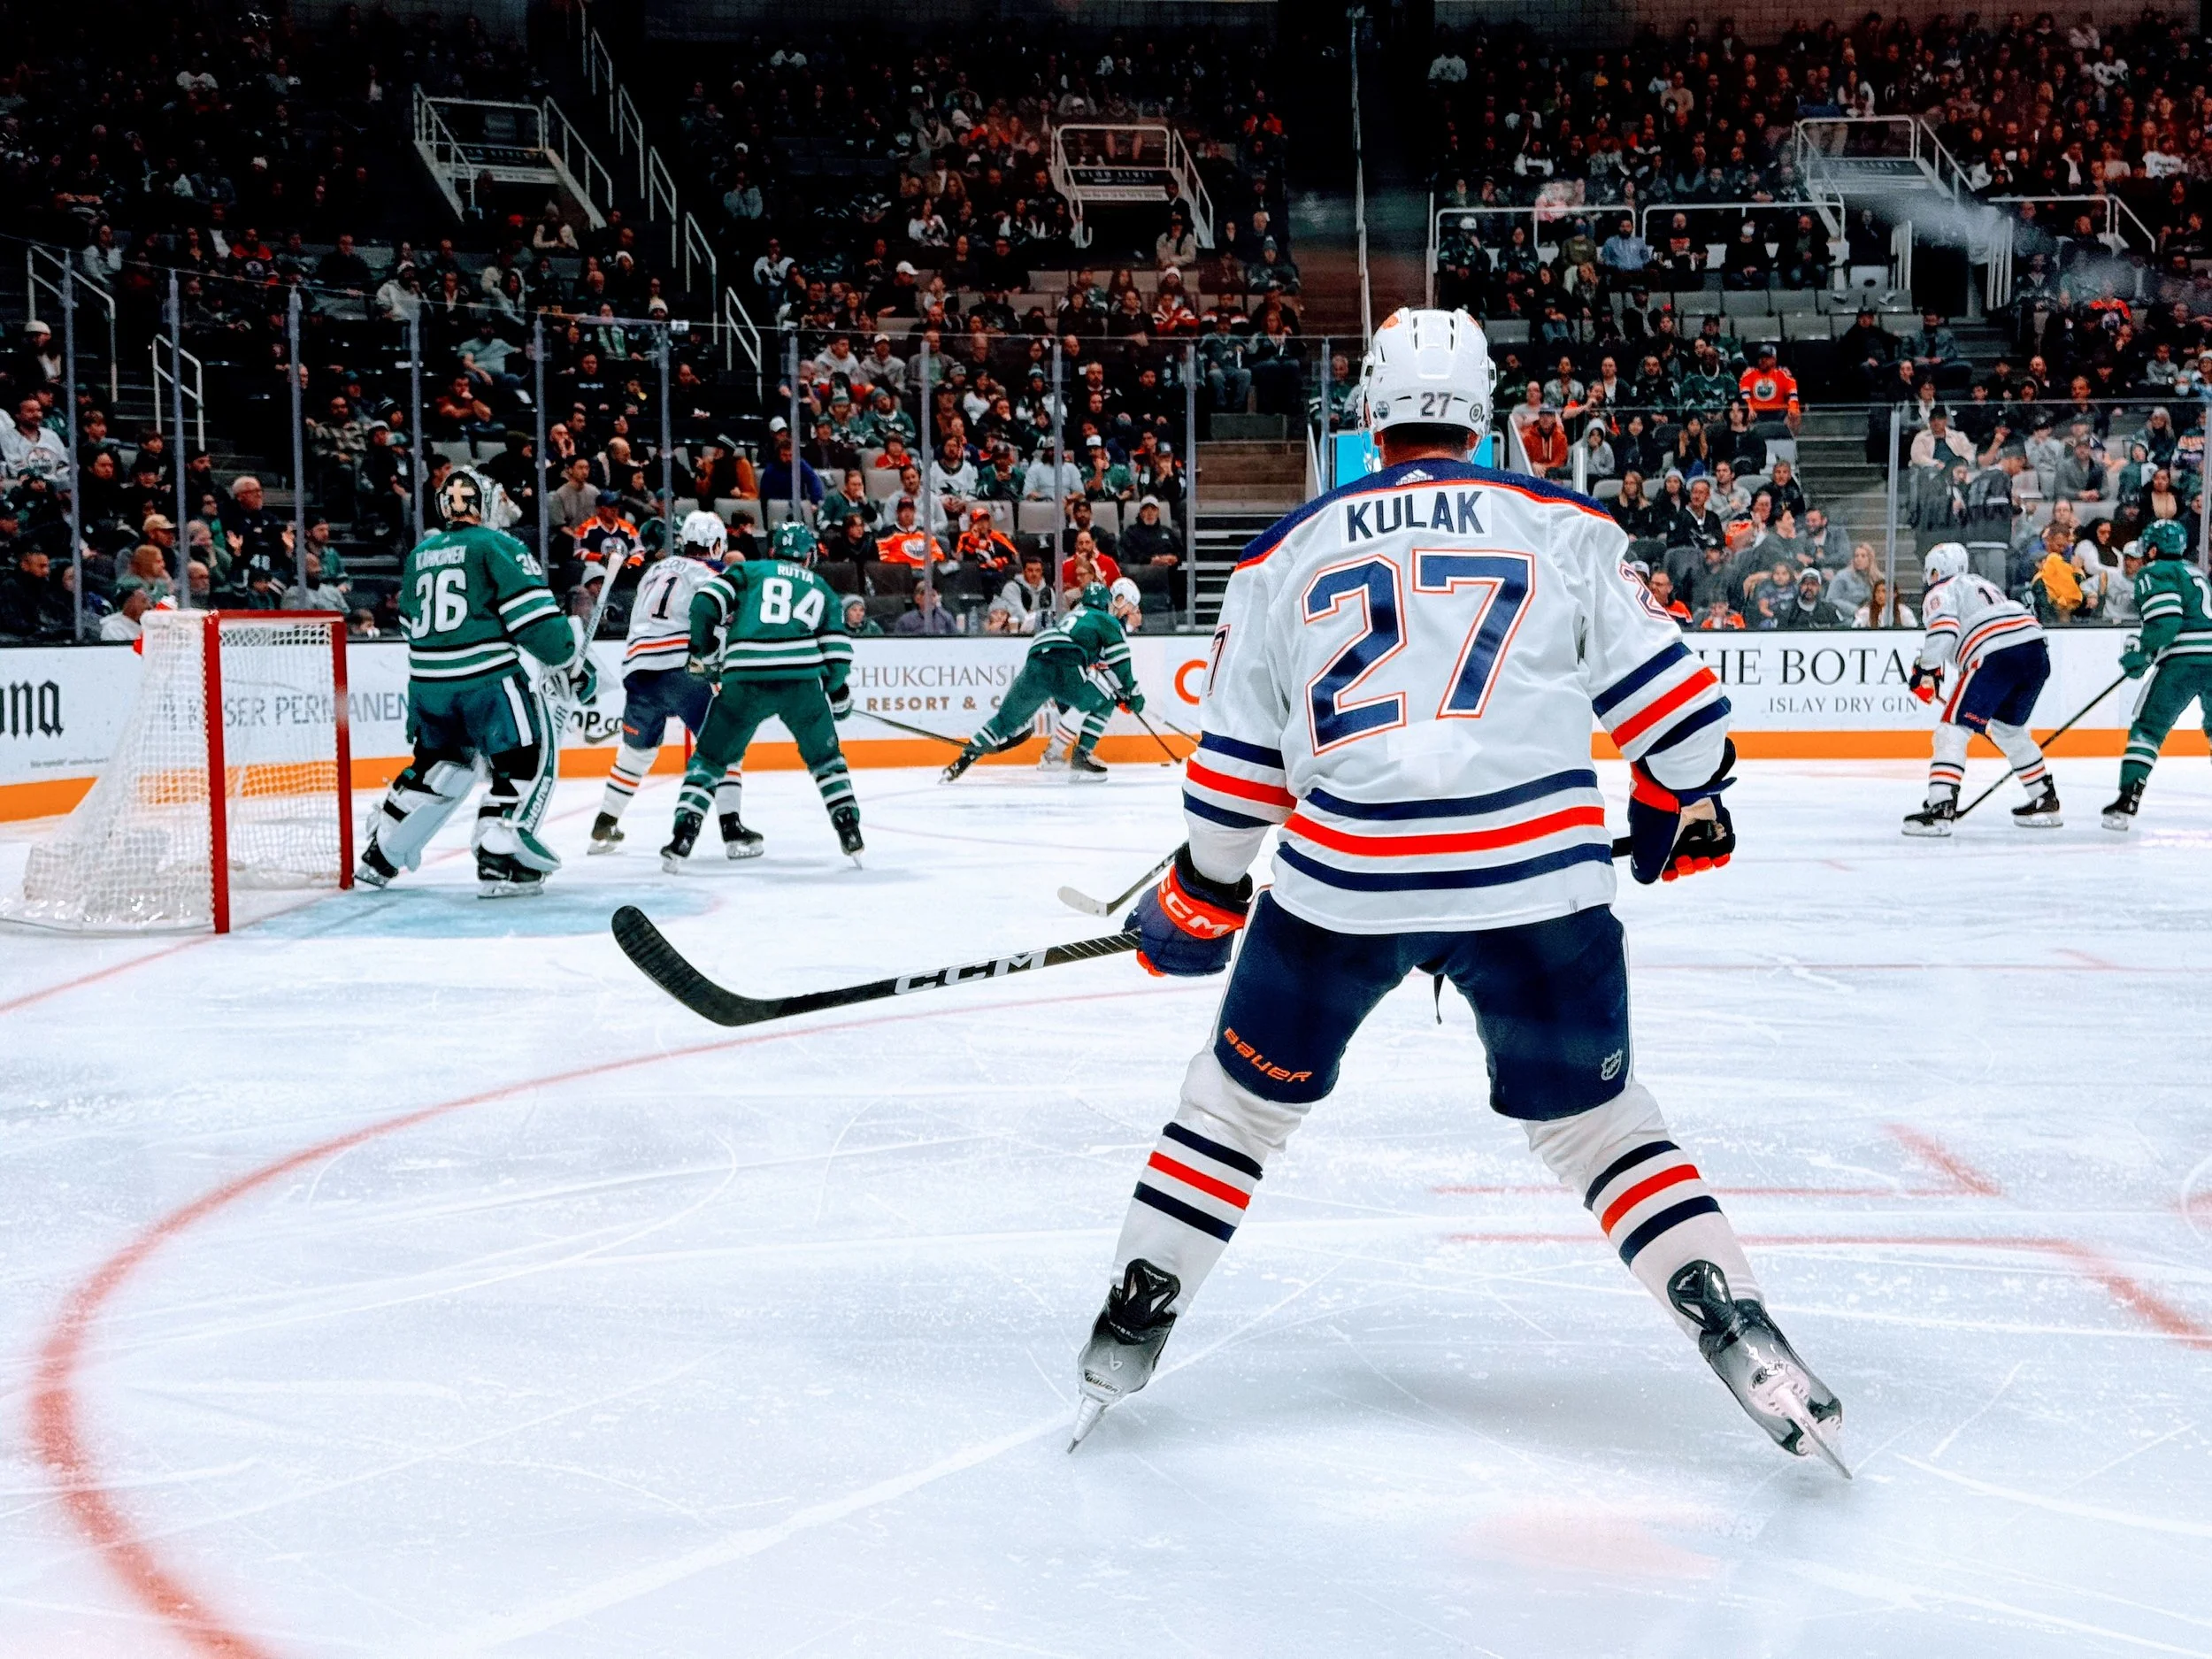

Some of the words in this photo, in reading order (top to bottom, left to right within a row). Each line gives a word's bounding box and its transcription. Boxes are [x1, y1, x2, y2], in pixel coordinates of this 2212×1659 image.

[1419, 391, 1452, 419] 27
[1347, 491, 1485, 542] KULAK
[516, 552, 542, 576] 36
[778, 564, 814, 585] RUTTA
[2139, 573, 2152, 595] 11
[411, 568, 468, 639] 36
[759, 577, 826, 632] 84
[1302, 549, 1535, 757] 27
[866, 696, 950, 711] RESORT
[963, 695, 978, 710] &
[1770, 696, 1827, 713] ISLAY
[1835, 696, 1876, 712] DRY
[1882, 696, 1918, 712] GIN
[895, 949, 1048, 995] CCM
[1224, 1026, 1313, 1083] BAUER
